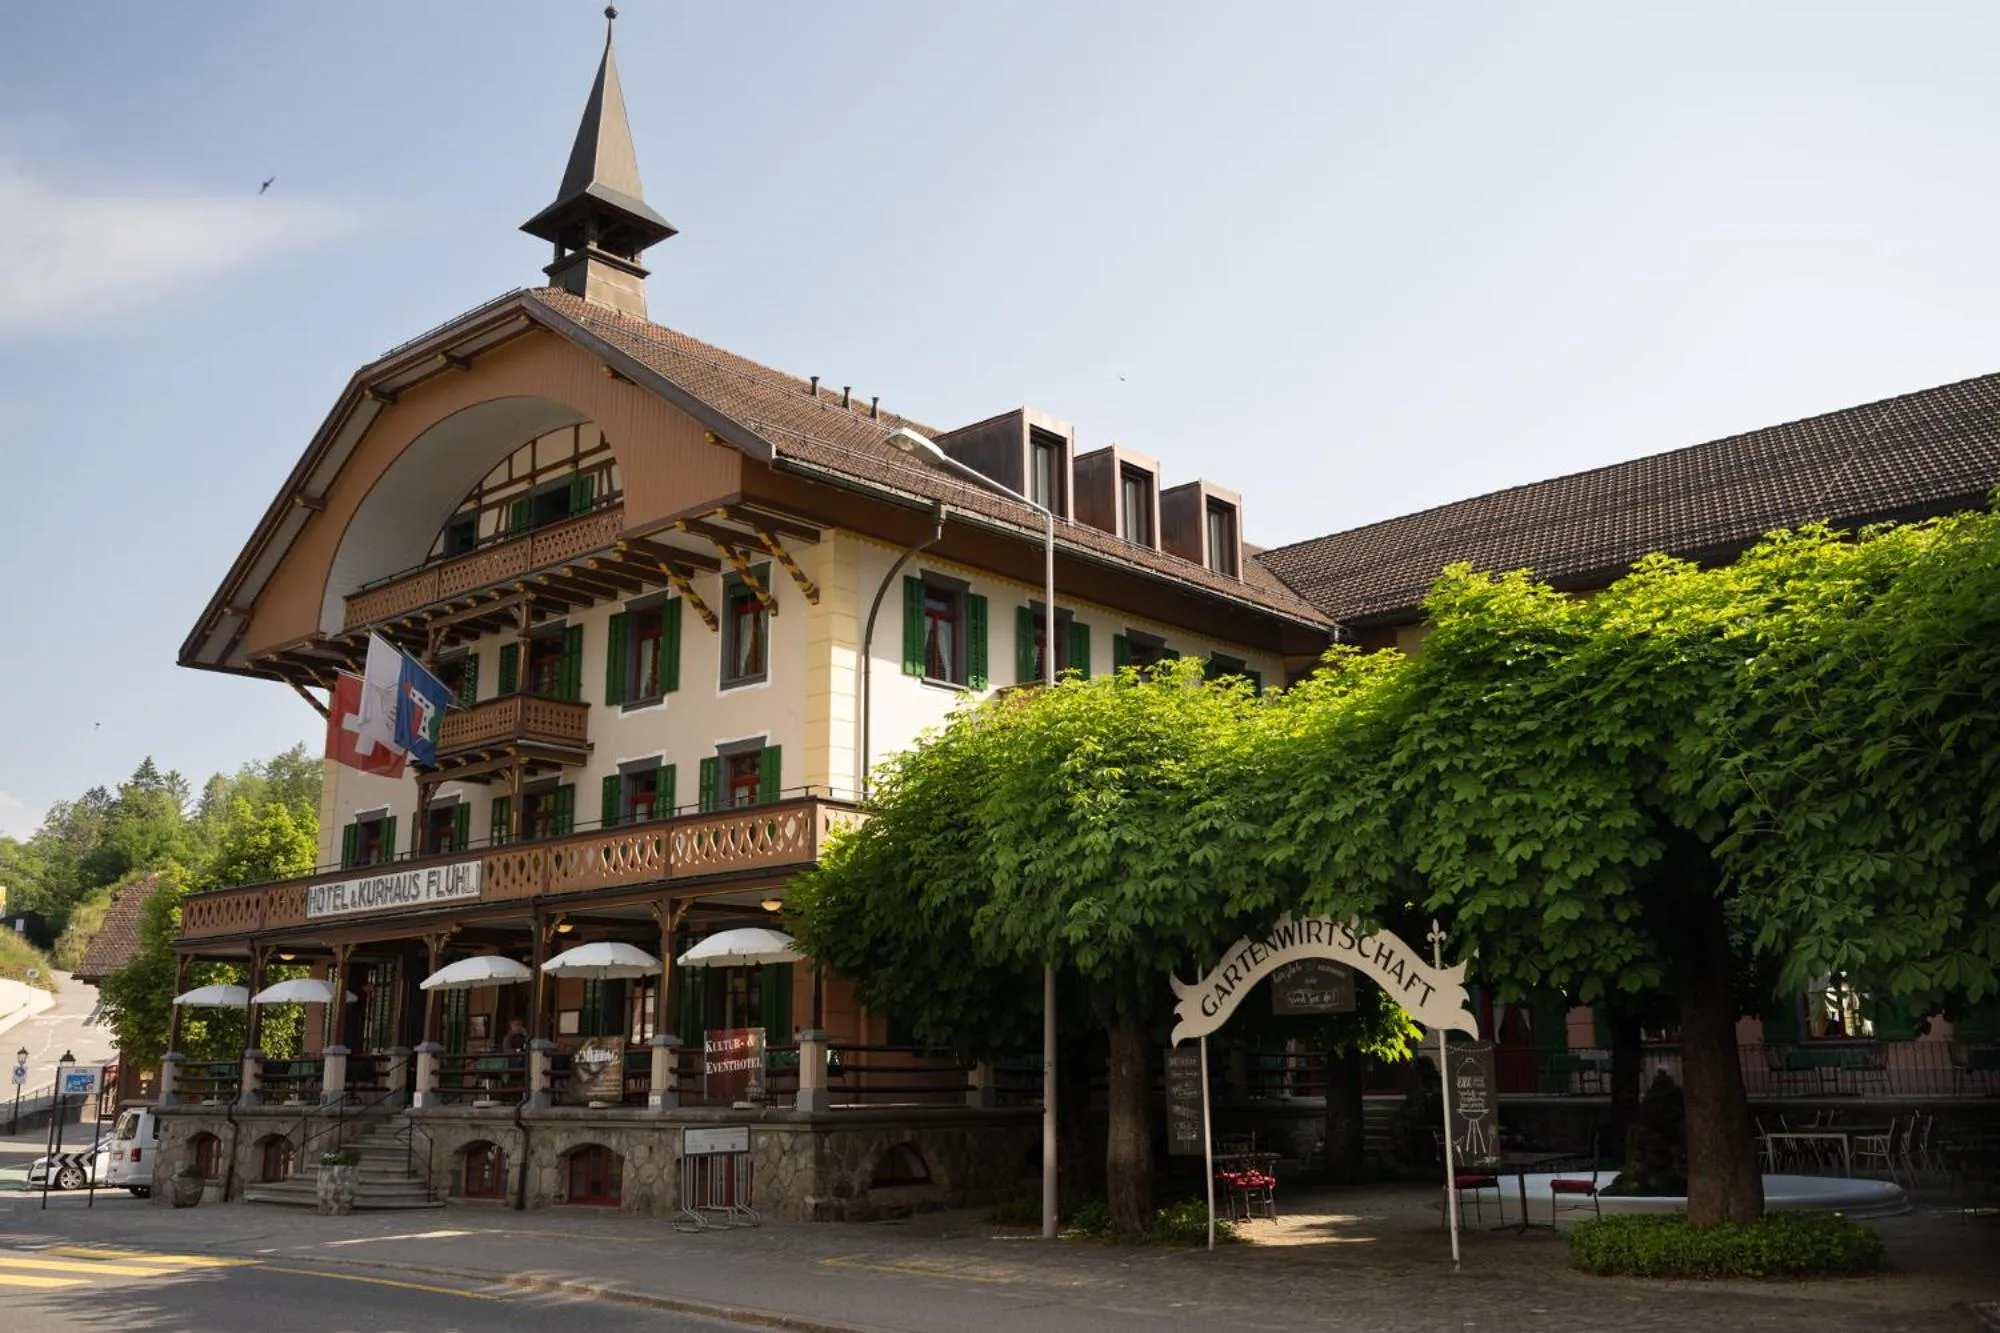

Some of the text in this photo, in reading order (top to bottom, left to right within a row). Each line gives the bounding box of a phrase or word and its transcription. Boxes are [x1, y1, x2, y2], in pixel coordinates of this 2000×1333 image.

[307, 884, 349, 915] HOTEL
[359, 873, 420, 908] KURHAUS
[1200, 920, 1436, 1017] GARTENWIRTSCHAFT
[706, 1057, 762, 1074] EVENTHOTEL
